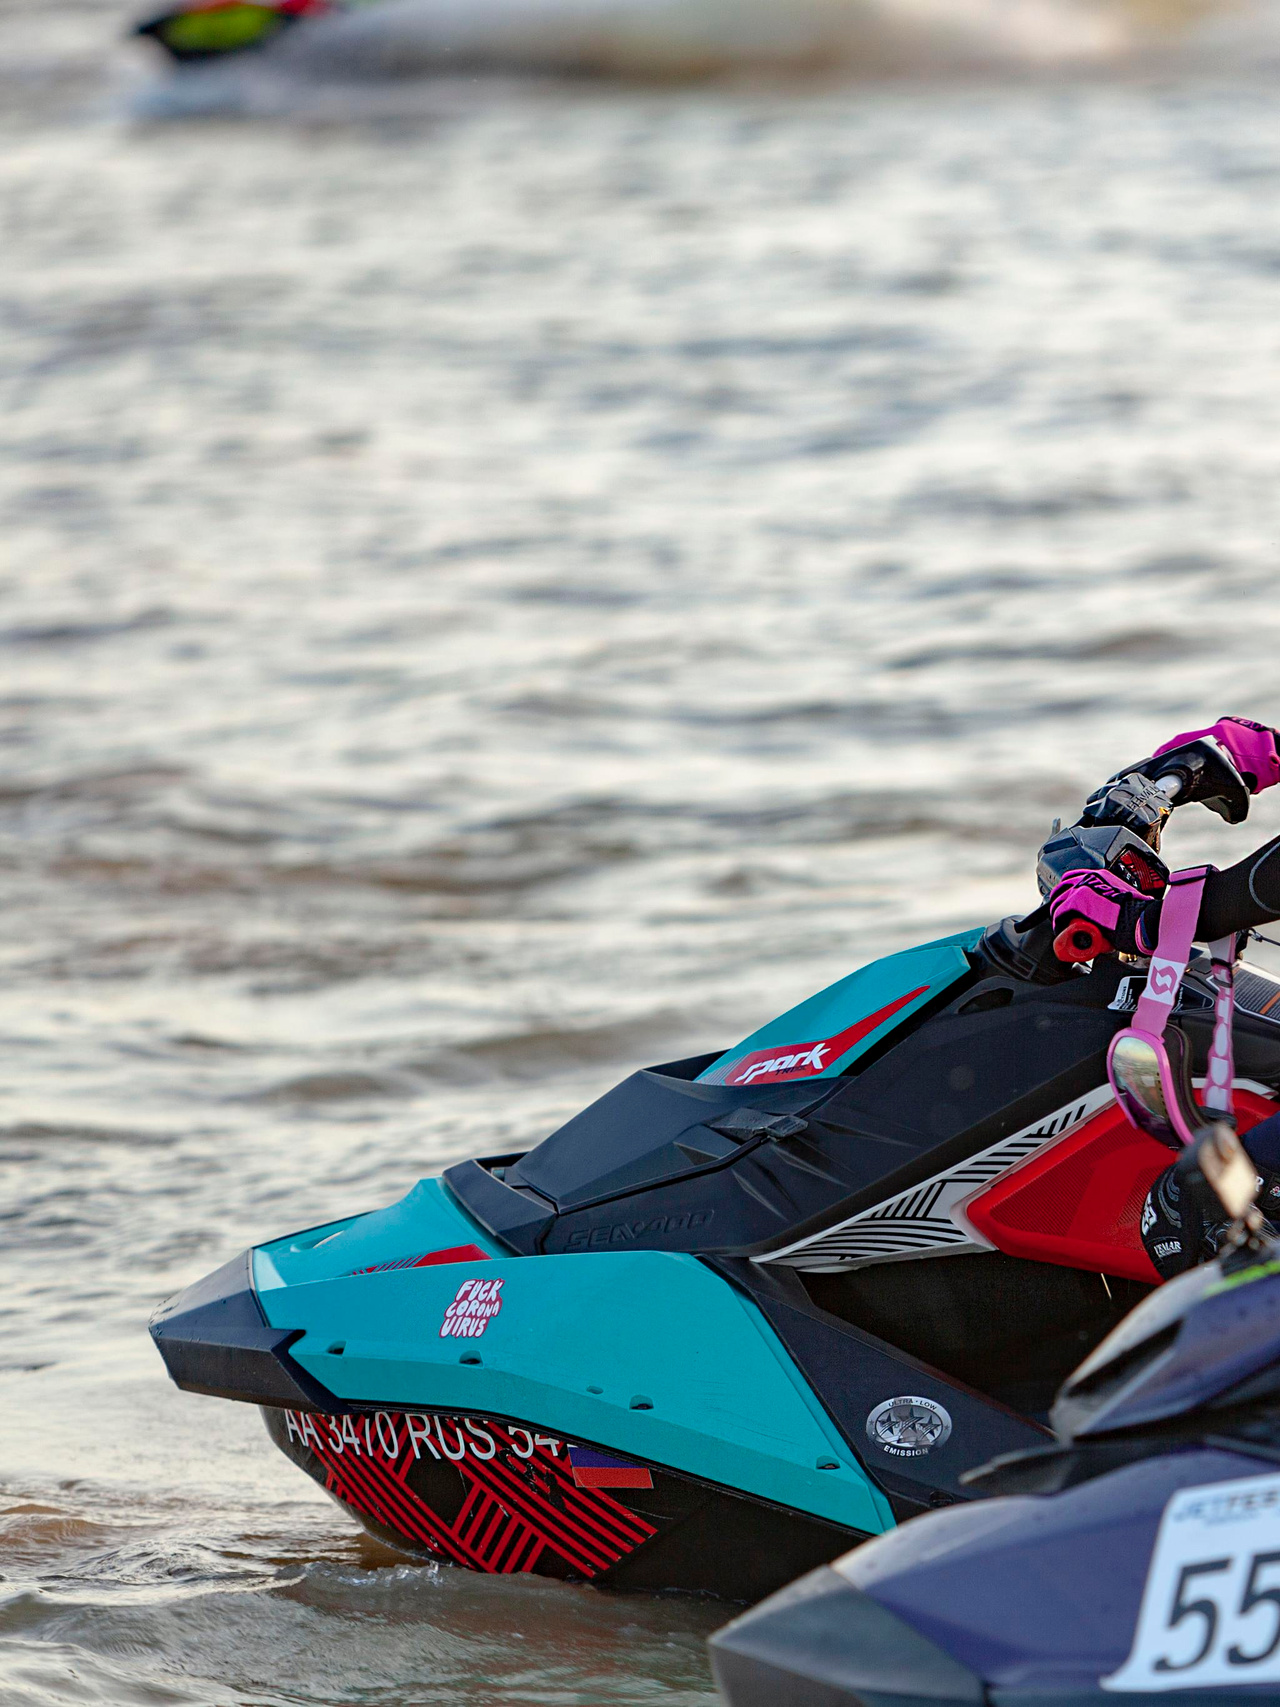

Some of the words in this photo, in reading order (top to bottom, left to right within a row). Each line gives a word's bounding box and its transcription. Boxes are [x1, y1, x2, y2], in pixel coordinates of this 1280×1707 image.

[456, 1280, 503, 1302] FUCK
[445, 1300, 500, 1318] CORONA
[440, 1316, 487, 1337] VIRUS
[920, 1400, 938, 1412] LOW
[284, 1408, 324, 1450] AA
[883, 1444, 929, 1457] EMISSION
